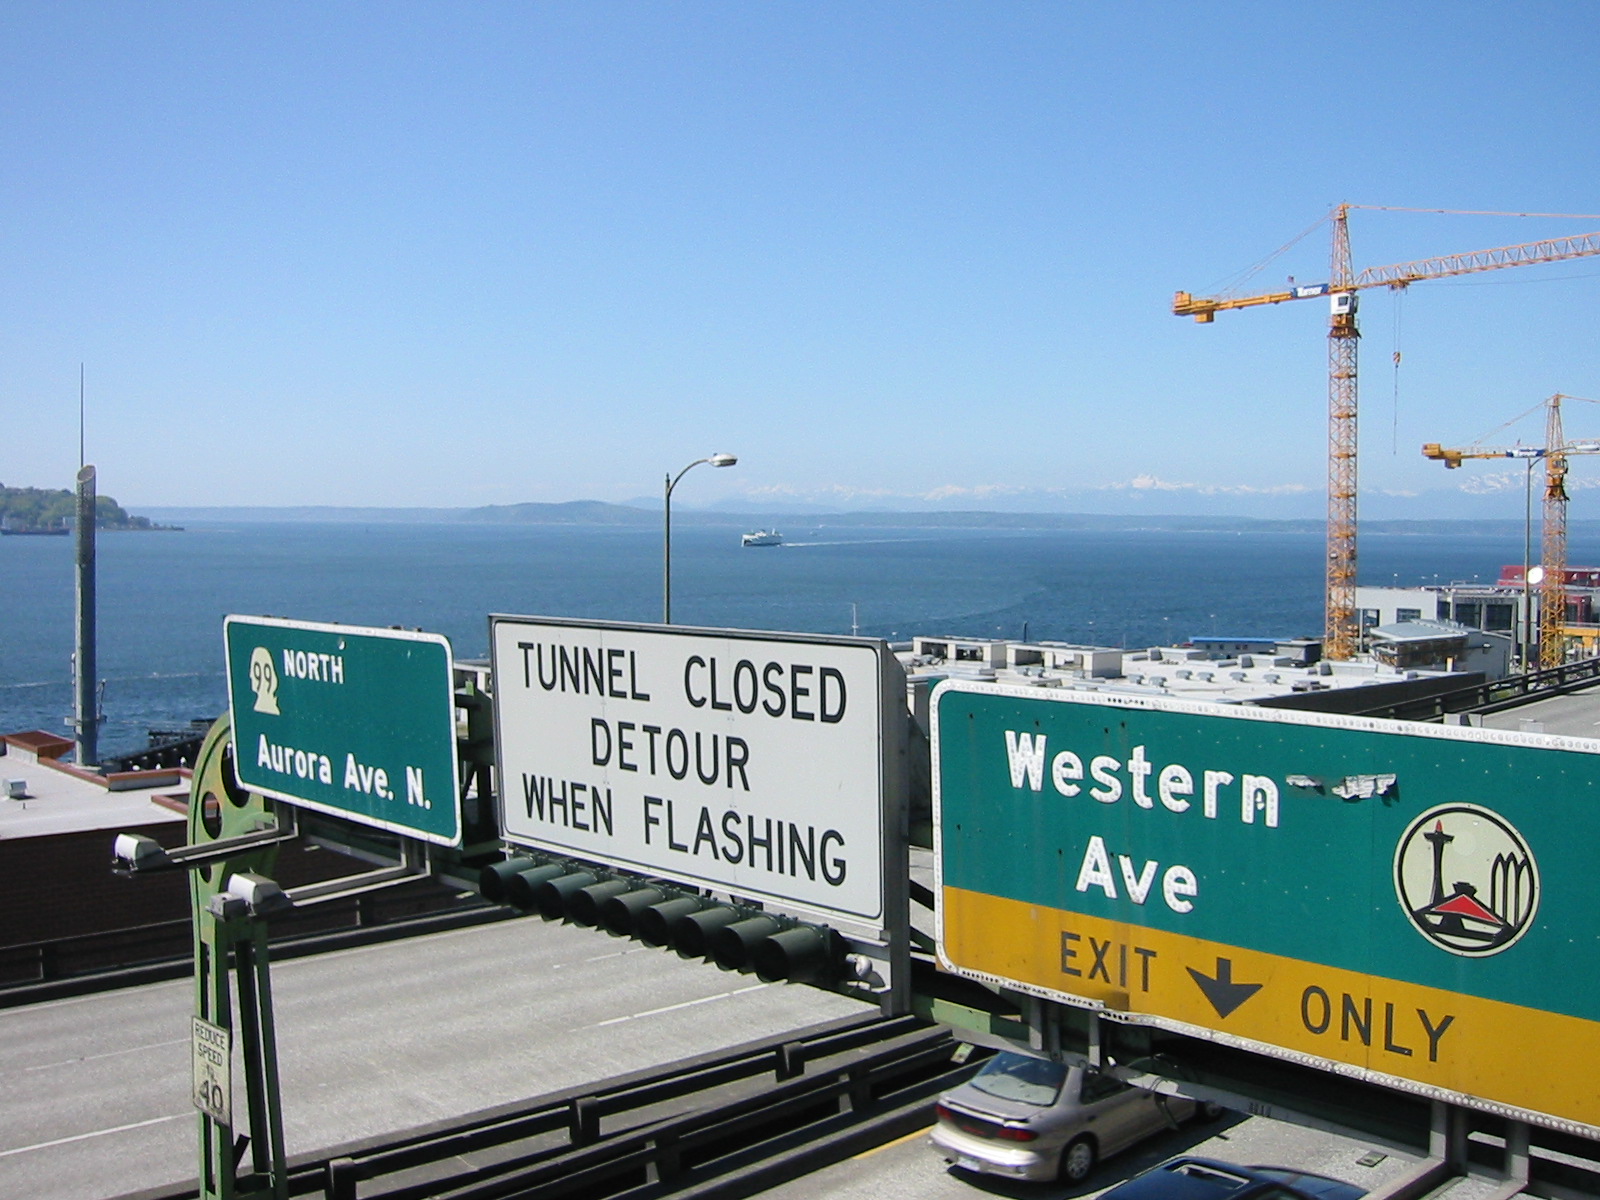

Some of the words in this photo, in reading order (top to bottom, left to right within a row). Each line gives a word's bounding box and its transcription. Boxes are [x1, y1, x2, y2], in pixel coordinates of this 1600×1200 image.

[253, 661, 272, 694] 99
[283, 648, 344, 684] NORTH
[517, 641, 651, 702] TUNNEL
[684, 654, 847, 724] CLOSED
[257, 733, 333, 785] Aurora
[344, 753, 395, 801] Ave.
[405, 766, 432, 810] N.
[591, 717, 751, 792] DETOUR
[1004, 729, 1281, 829] Western
[521, 772, 614, 837] WHEN
[643, 795, 847, 887] FLASHING
[1075, 835, 1199, 914] Ave
[1060, 931, 1158, 993] EXIT
[1301, 984, 1455, 1063] ONLY
[195, 1022, 226, 1051] REDUCE
[198, 1042, 223, 1067] SPEED
[199, 1079, 223, 1115] 40
